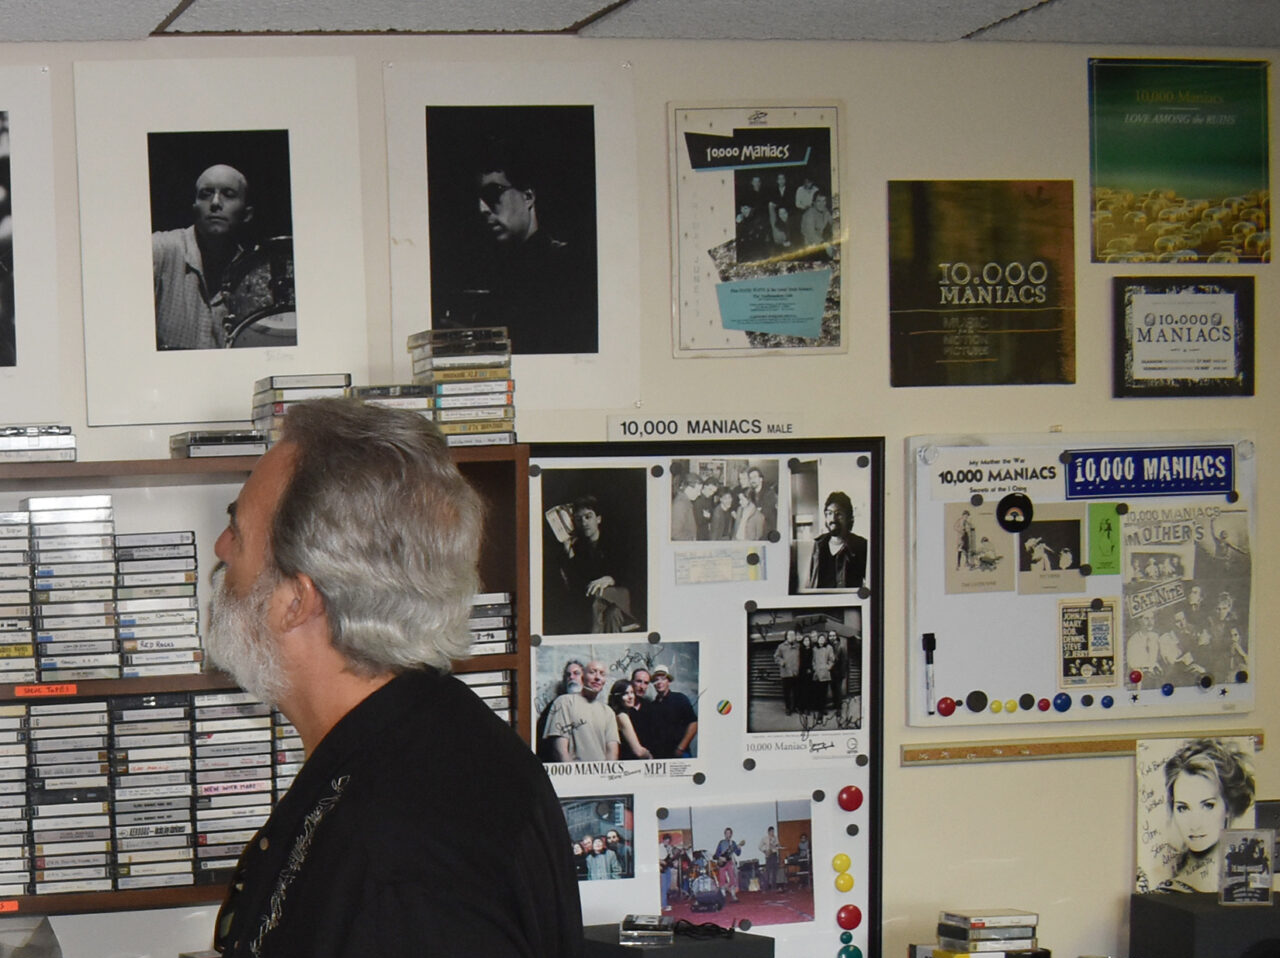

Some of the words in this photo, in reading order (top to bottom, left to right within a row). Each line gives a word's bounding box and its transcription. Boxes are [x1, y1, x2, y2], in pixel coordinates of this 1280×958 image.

[1124, 114, 1151, 124] LOVE
[1152, 114, 1190, 124] AMONG
[741, 144, 790, 161] Maniacs
[938, 261, 1048, 285] 10.000
[939, 285, 1047, 305] MANIACS
[1159, 314, 1208, 325] 10.000
[1136, 326, 1232, 343] MANIACS
[620, 420, 678, 438] 10,000
[686, 419, 762, 435] MANIACS
[766, 423, 793, 434] MALE
[938, 469, 983, 486] 10,000
[987, 466, 1057, 482] MANIACS
[1075, 457, 1135, 484] 10,000
[1143, 455, 1226, 482] MANIACS
[1161, 507, 1221, 521] MANIACS
[746, 742, 773, 753] 10,000
[774, 741, 807, 751] Maniacs
[574, 761, 625, 776] MANIACS
[644, 762, 667, 775] MPI
